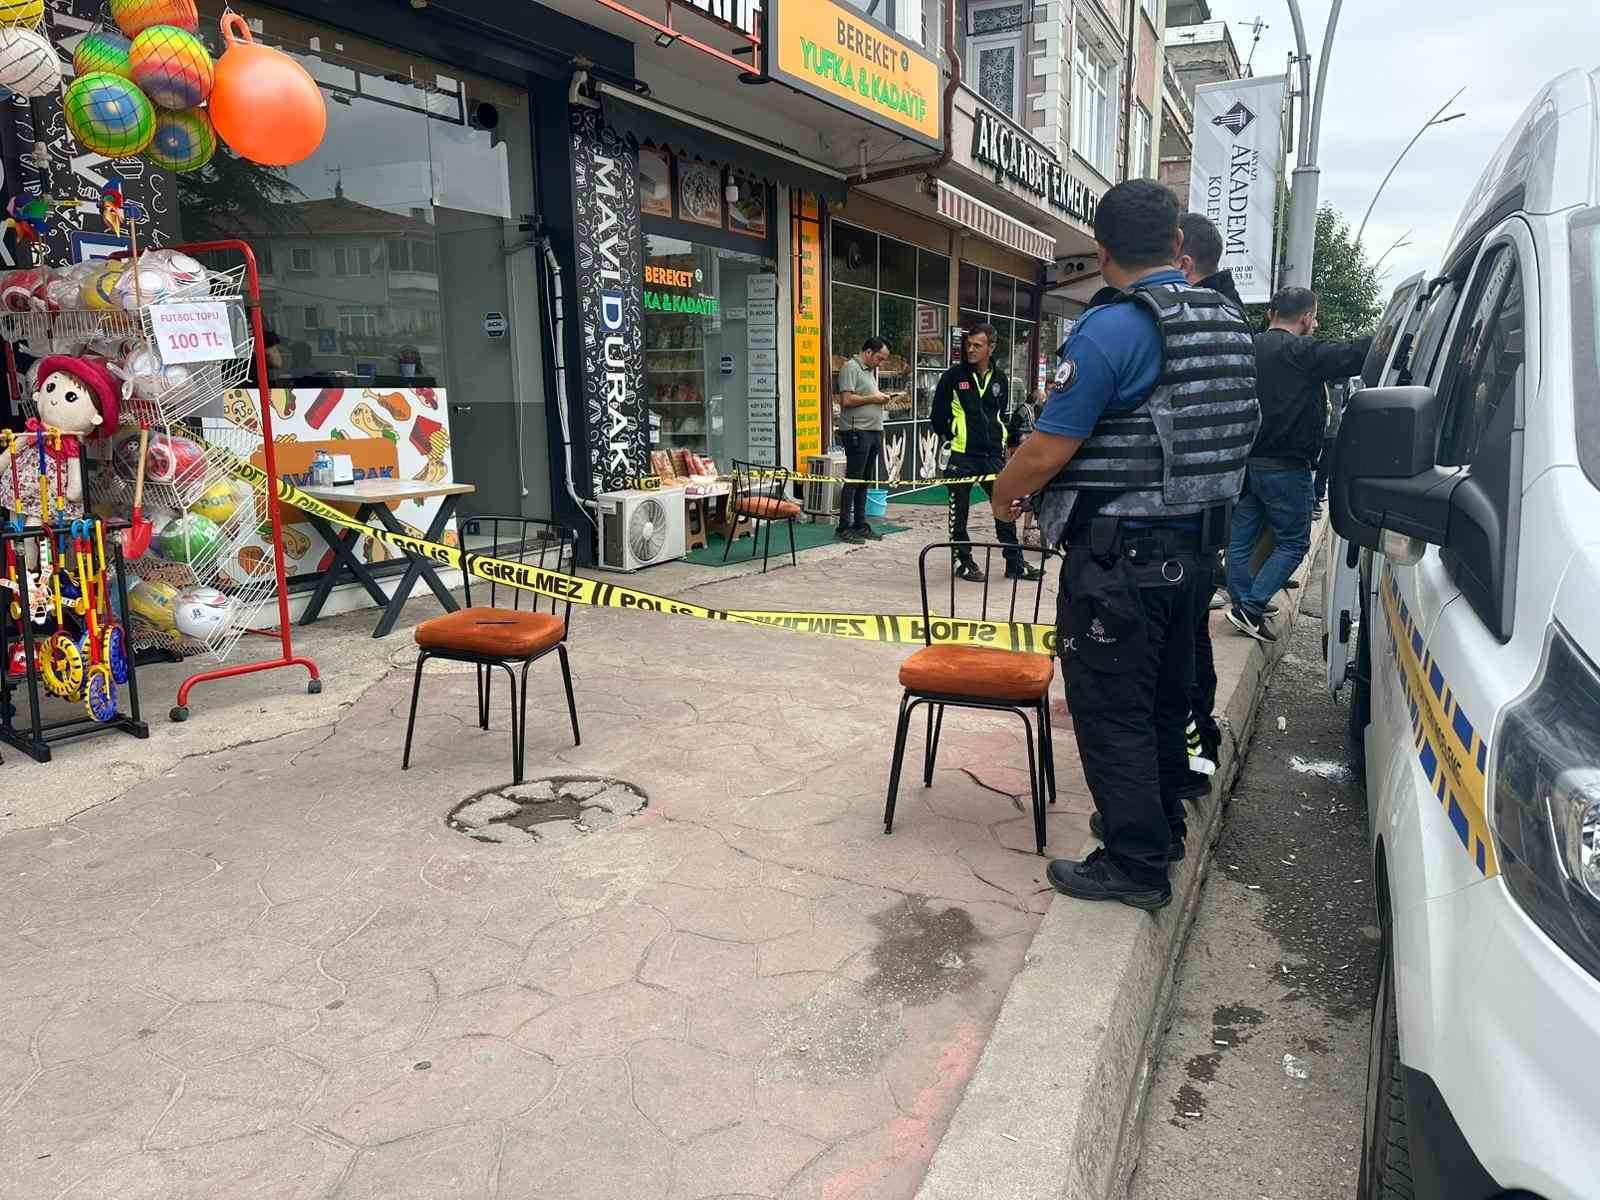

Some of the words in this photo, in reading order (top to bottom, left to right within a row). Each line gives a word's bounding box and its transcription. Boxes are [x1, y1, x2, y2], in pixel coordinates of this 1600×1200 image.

[837, 16, 898, 73] BEREKET
[799, 36, 857, 91] YUFKA
[858, 67, 870, 97] &
[871, 73, 928, 122] KADAYIF
[593, 154, 621, 281] MAVI
[1052, 165, 1085, 220] EKMEK
[1206, 175, 1222, 226] KOLEJ
[1226, 143, 1251, 256] AKADEMİ
[645, 265, 694, 288] BEREKET
[160, 313, 194, 322] FUTBOL
[195, 311, 219, 320] TOPU
[168, 333, 199, 349] 100
[202, 331, 223, 346] TL
[602, 296, 630, 473] DURAK
[479, 561, 583, 599] GİRİLMEZ
